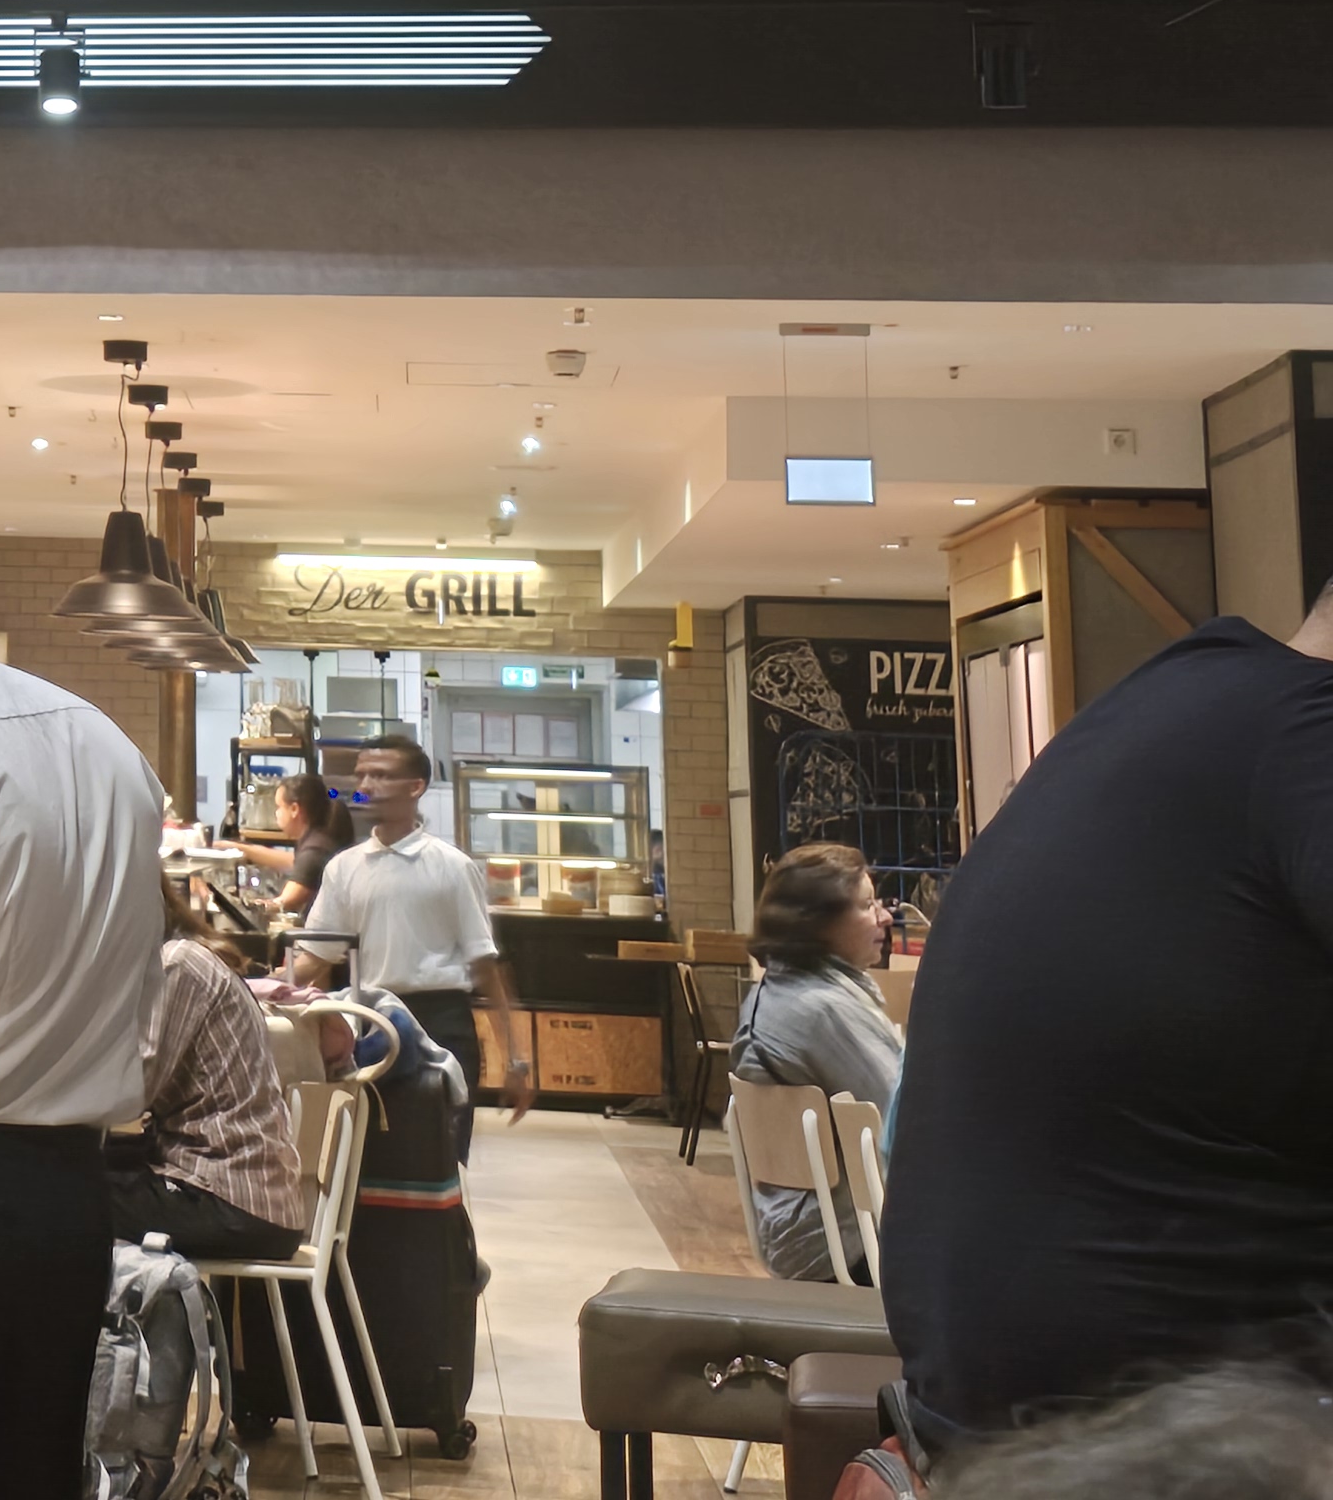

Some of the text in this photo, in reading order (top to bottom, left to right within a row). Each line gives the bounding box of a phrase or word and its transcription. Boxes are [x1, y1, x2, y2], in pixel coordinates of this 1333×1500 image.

[287, 563, 537, 618] Der GRILL
[869, 650, 955, 695] PIZZ
